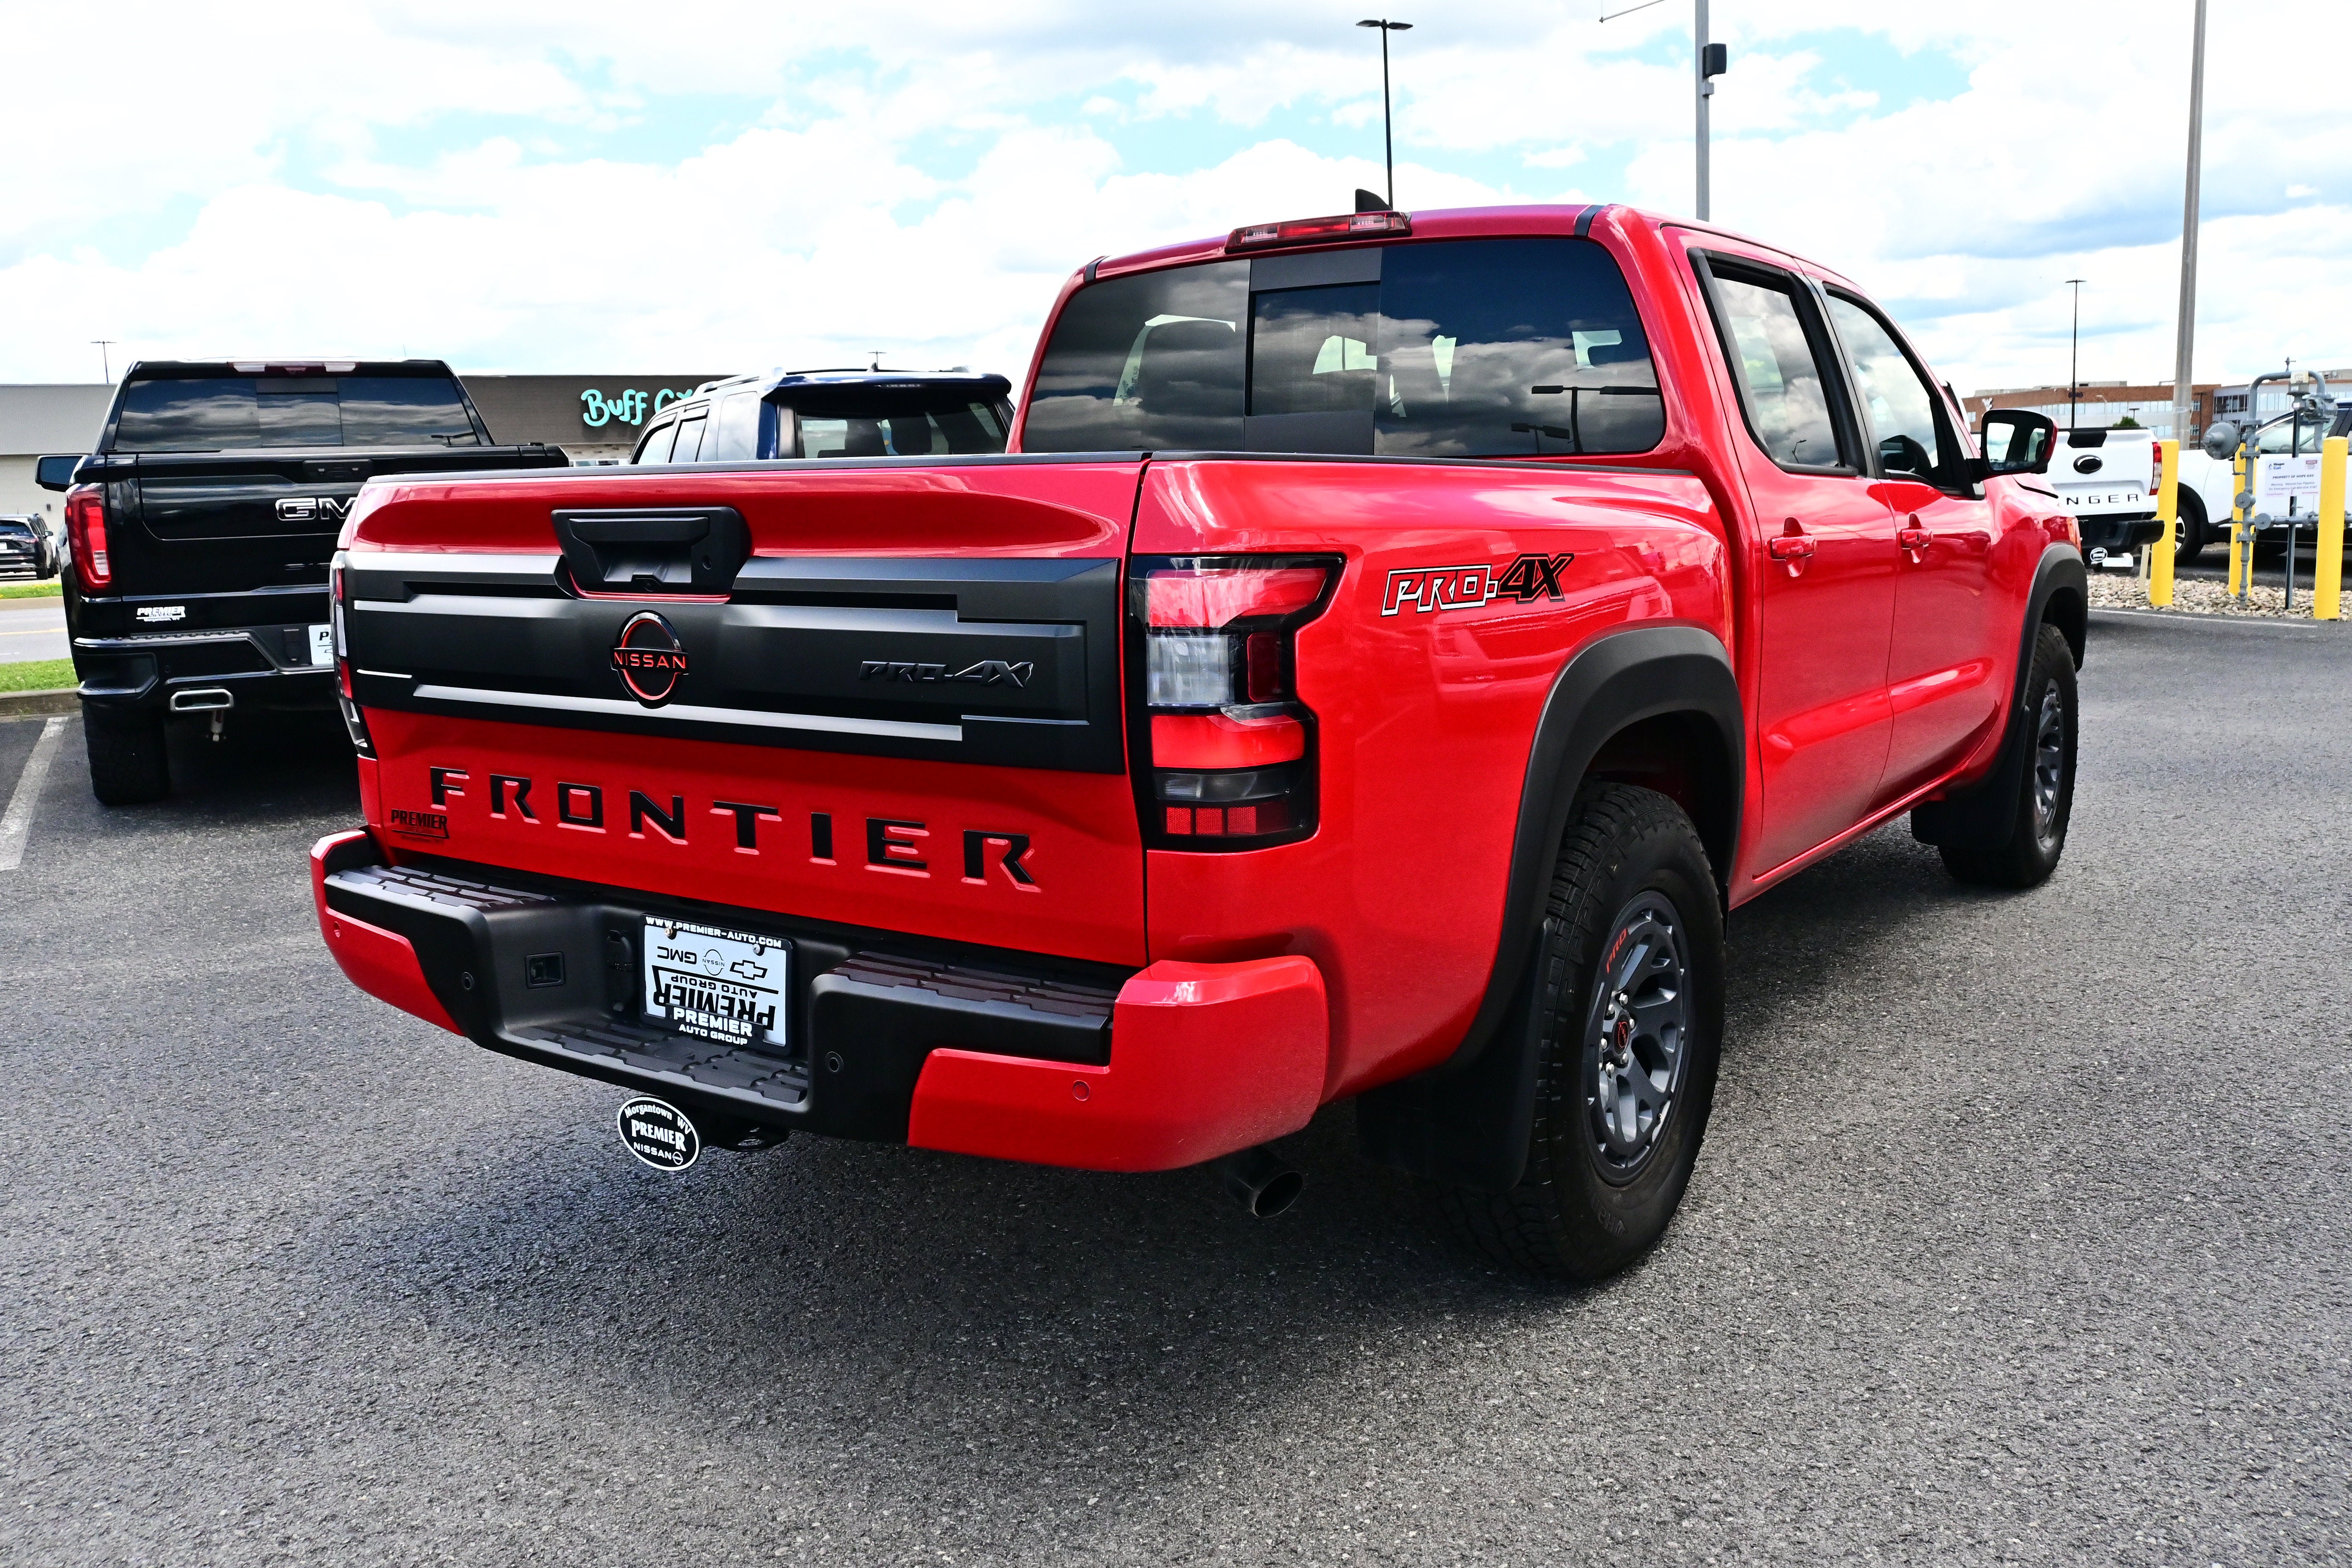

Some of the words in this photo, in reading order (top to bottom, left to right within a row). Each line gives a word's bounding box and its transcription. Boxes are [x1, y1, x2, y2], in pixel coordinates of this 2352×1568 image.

[581, 389, 648, 427] Buff
[275, 497, 357, 521] GM
[2066, 494, 2139, 505] NGER
[1380, 553, 1575, 618] PRO-4X
[136, 606, 185, 616] PREMIER
[614, 652, 686, 669] NISSAN
[859, 660, 1033, 688] PRO-4X
[391, 808, 448, 830] PREMIER
[430, 766, 1041, 892] FRONTIER
[645, 916, 781, 948] WWW.PREMIER-AUTO.COM
[657, 946, 697, 965] GMC
[702, 958, 725, 967] NISSAN
[671, 975, 716, 990] GROUP
[721, 984, 757, 999] AUTO
[653, 983, 776, 1031] PREMIER
[673, 1007, 753, 1037] PREMIER
[678, 1024, 708, 1037] AUTO
[710, 1031, 748, 1045] GROUP
[624, 1104, 672, 1120] Morgantown
[677, 1116, 691, 1135] WV
[631, 1119, 687, 1152] PREMIER
[634, 1142, 672, 1160] NISSAN
